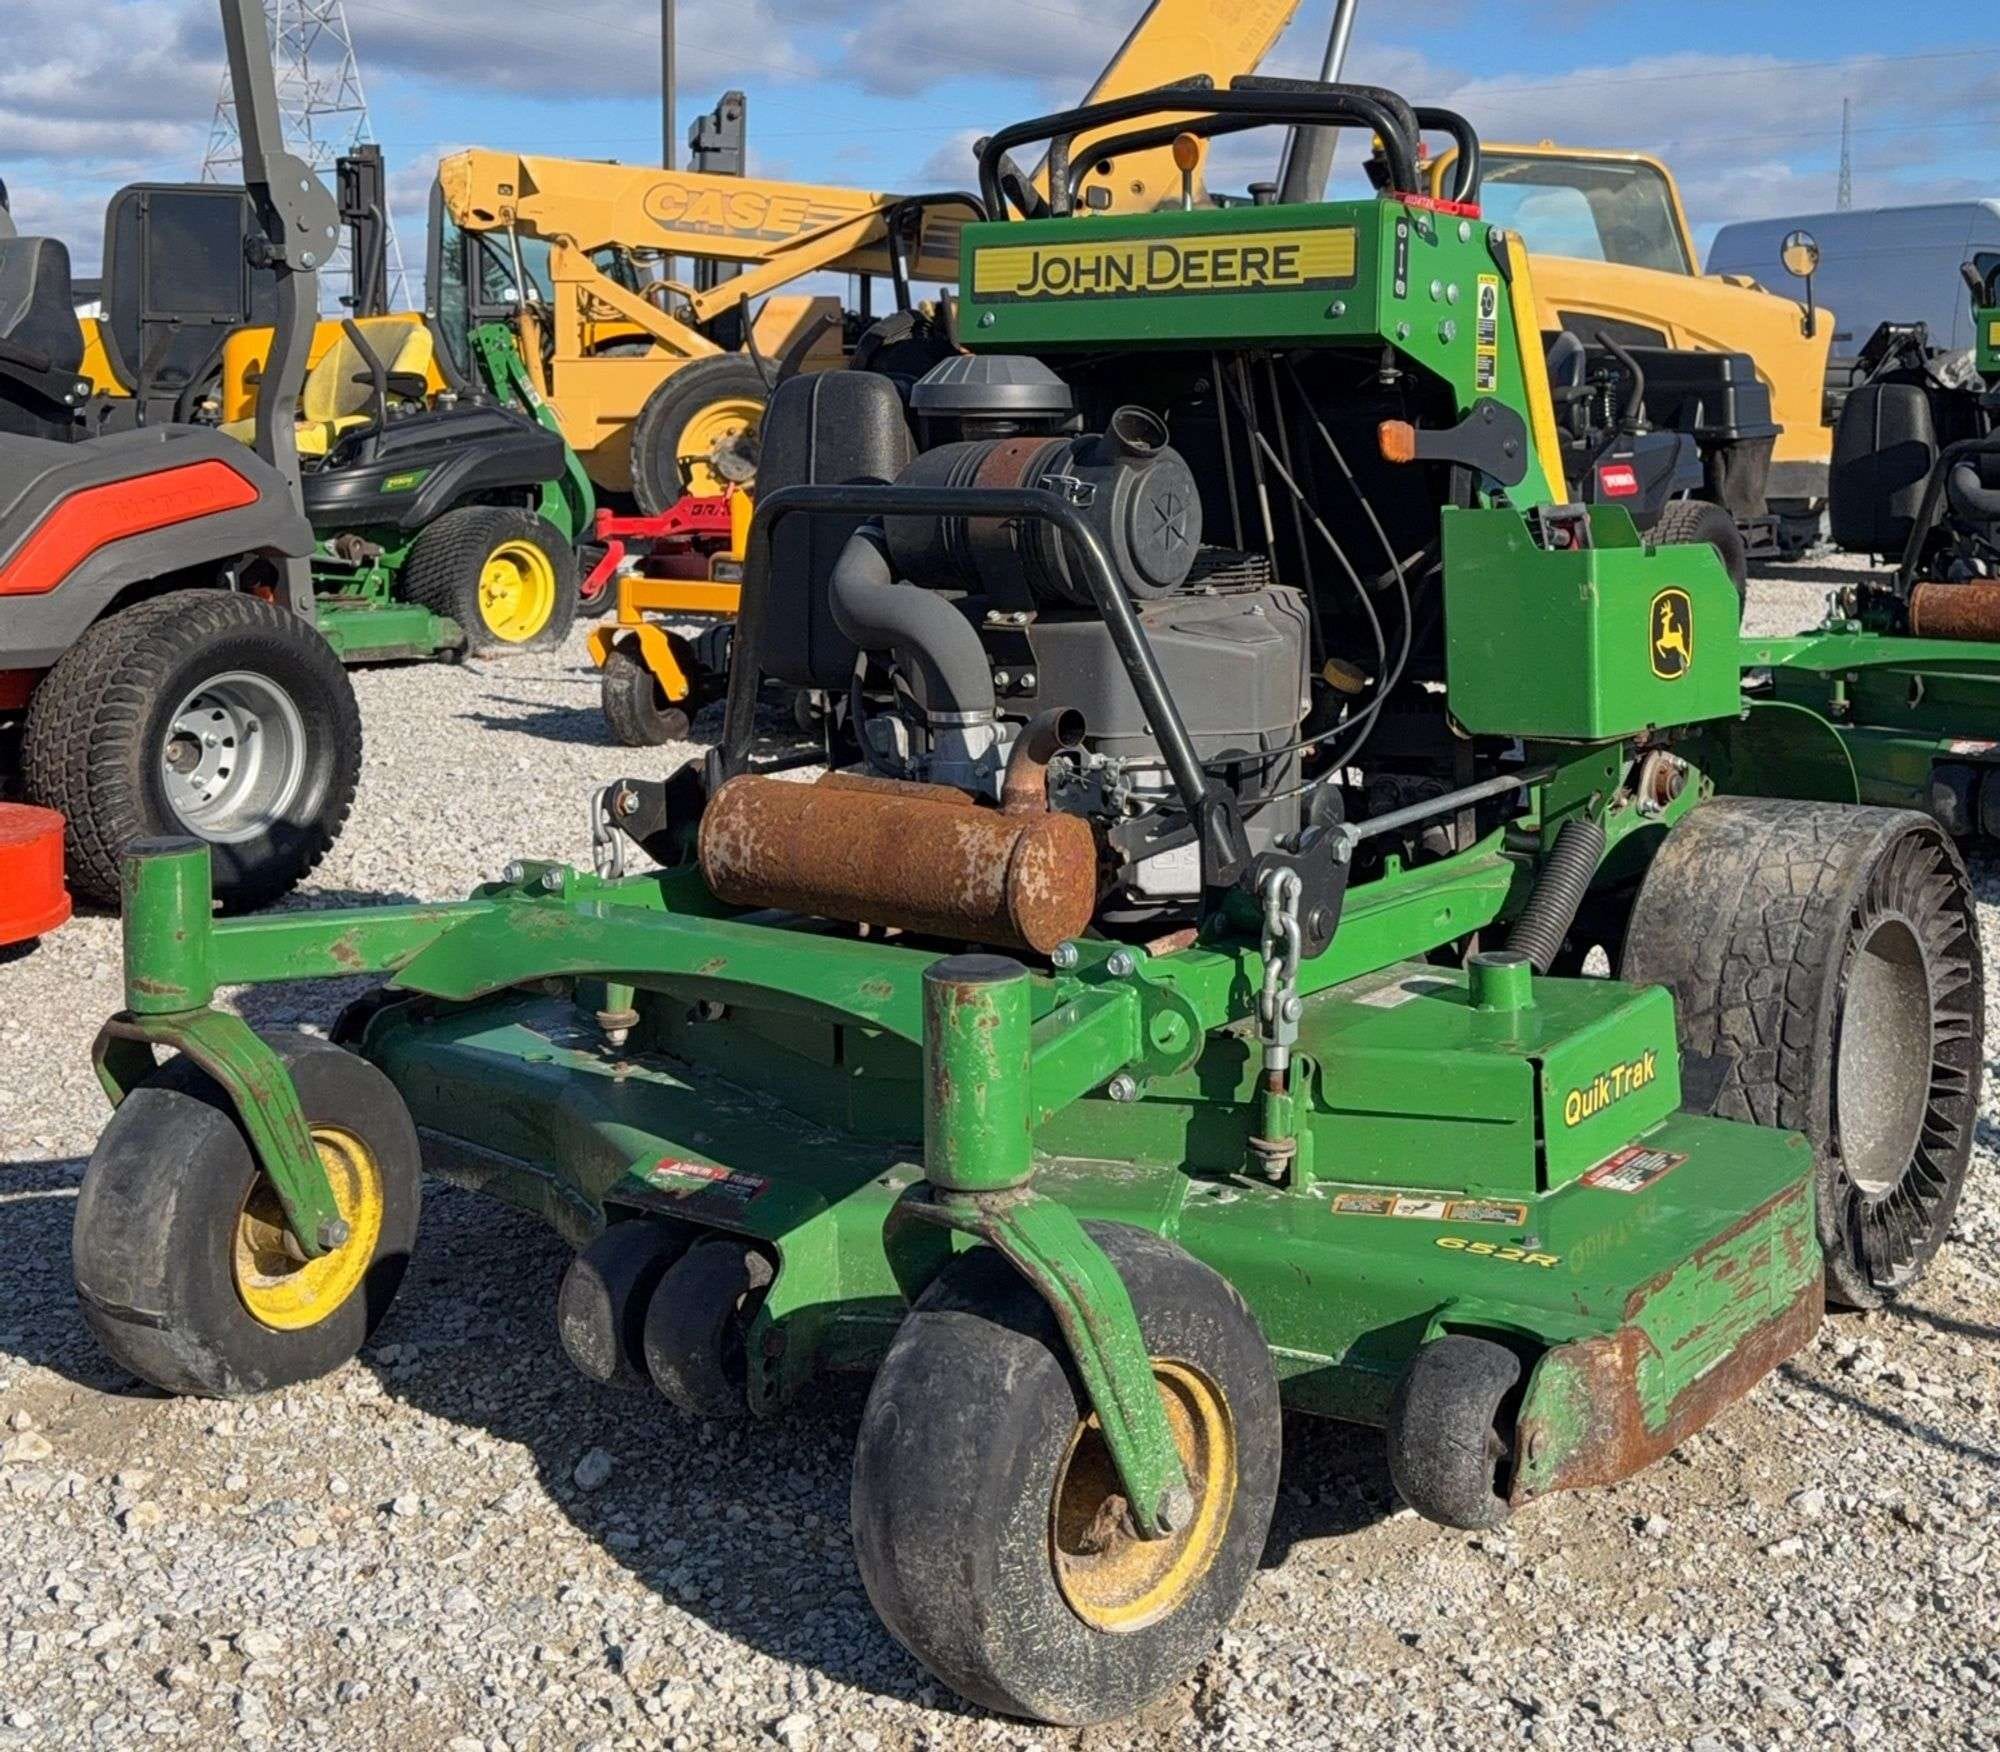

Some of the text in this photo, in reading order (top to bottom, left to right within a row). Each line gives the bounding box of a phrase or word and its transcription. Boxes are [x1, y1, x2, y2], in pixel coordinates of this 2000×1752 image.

[644, 183, 810, 233] CASE
[1017, 244, 1300, 292] JOHN DEERE
[1434, 1237, 1560, 1268] 652R
